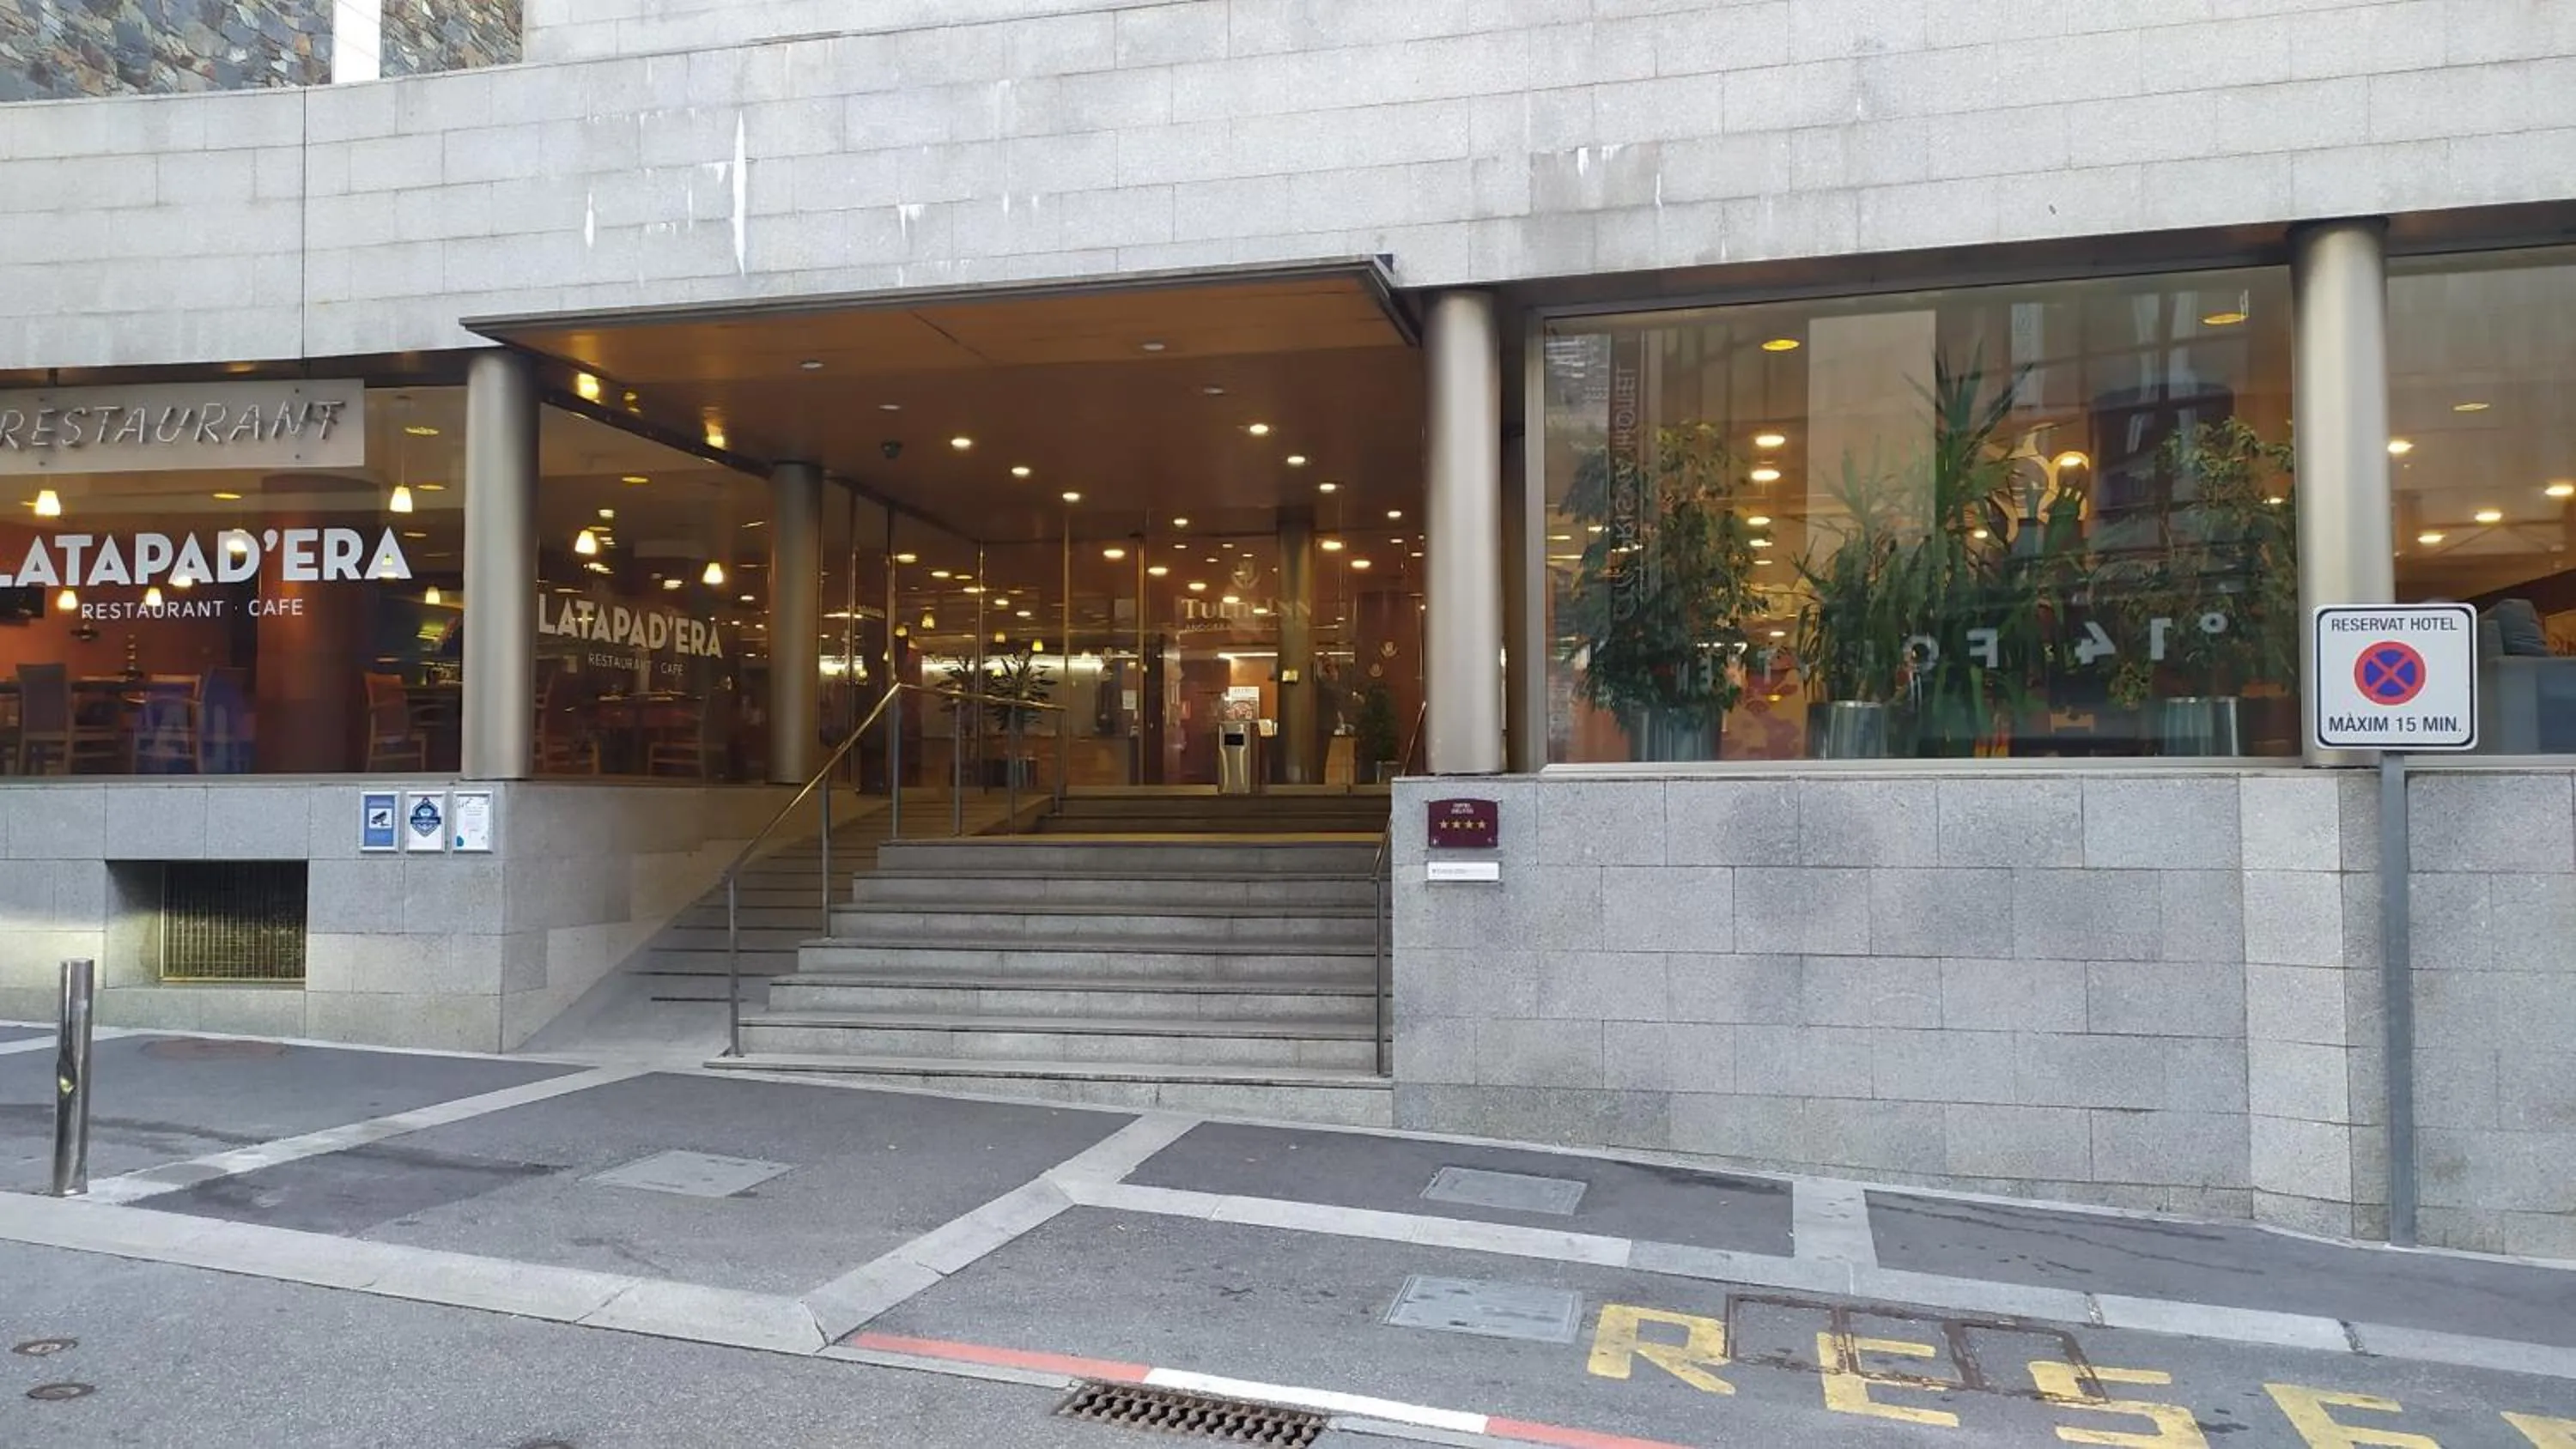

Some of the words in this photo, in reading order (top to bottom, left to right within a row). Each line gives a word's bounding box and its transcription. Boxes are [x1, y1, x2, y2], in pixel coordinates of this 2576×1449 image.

[0, 400, 345, 451] RESTAURANT
[82, 600, 225, 620] RESTAURANT
[248, 598, 304, 617] CAFE
[538, 593, 723, 659] LATAPAD'ERA
[2331, 617, 2405, 632] RESERVAT
[2410, 616, 2458, 631] HOTEL
[2328, 712, 2389, 732] MÀXIM
[2396, 717, 2417, 732] 15
[2422, 716, 2463, 733] MIN.
[1588, 1303, 2576, 1449] RESE
